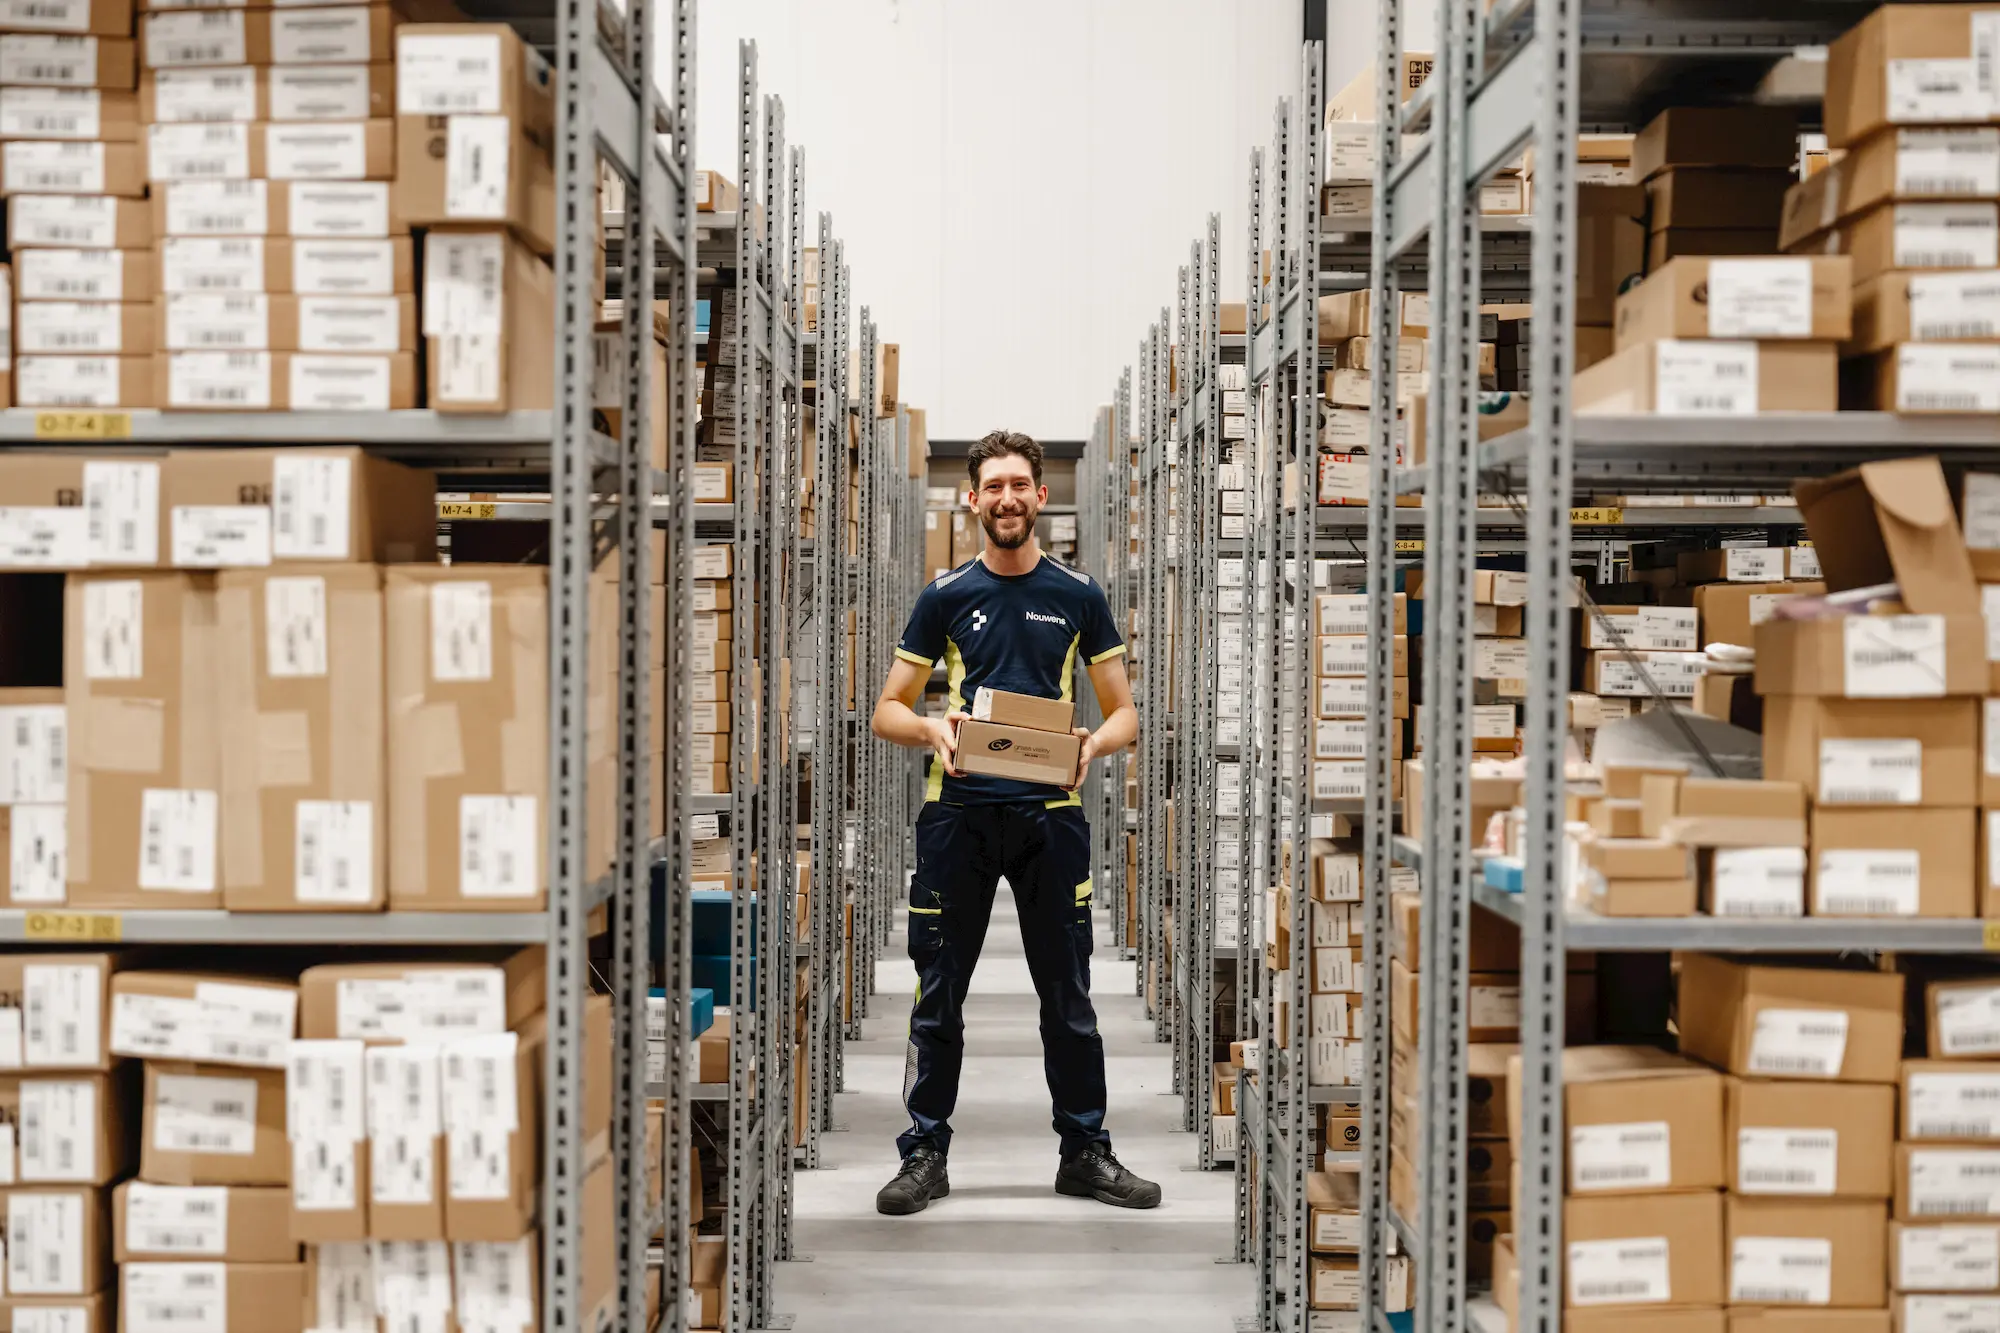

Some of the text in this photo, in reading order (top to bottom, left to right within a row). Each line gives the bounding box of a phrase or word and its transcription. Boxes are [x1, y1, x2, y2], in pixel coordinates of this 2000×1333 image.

[442, 505, 472, 515] M-7-4
[1570, 511, 1600, 521] M-8-4
[1025, 611, 1066, 625] Nouwens
